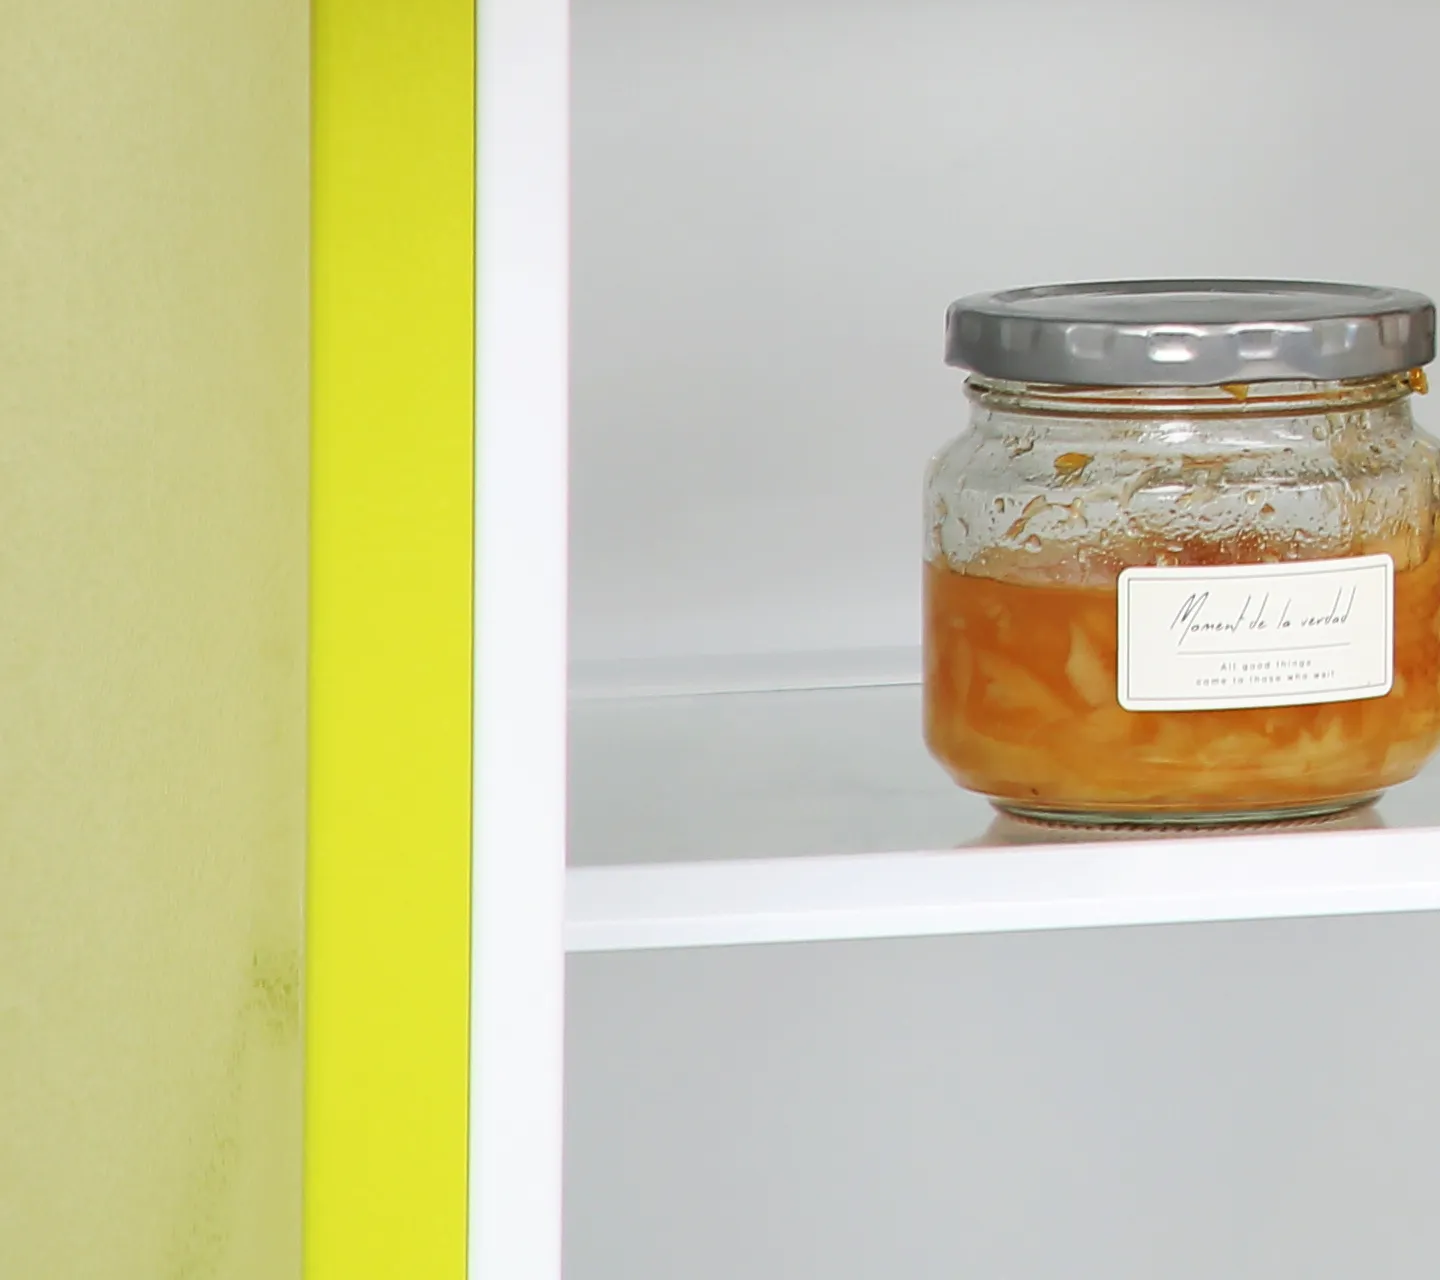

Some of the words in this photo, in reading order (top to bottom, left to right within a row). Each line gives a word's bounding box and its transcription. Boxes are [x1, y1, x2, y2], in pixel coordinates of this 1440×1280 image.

[1169, 590, 1252, 647] Moment
[1249, 591, 1268, 630] de
[1277, 598, 1292, 630] la
[1300, 585, 1357, 628] verdad
[1220, 661, 1237, 671] All
[1242, 660, 1272, 673] good
[1276, 658, 1313, 671] things
[1195, 676, 1228, 687] come
[1232, 675, 1245, 685] to
[1249, 673, 1282, 684] those
[1287, 672, 1309, 682] who
[1313, 669, 1335, 680] wait
